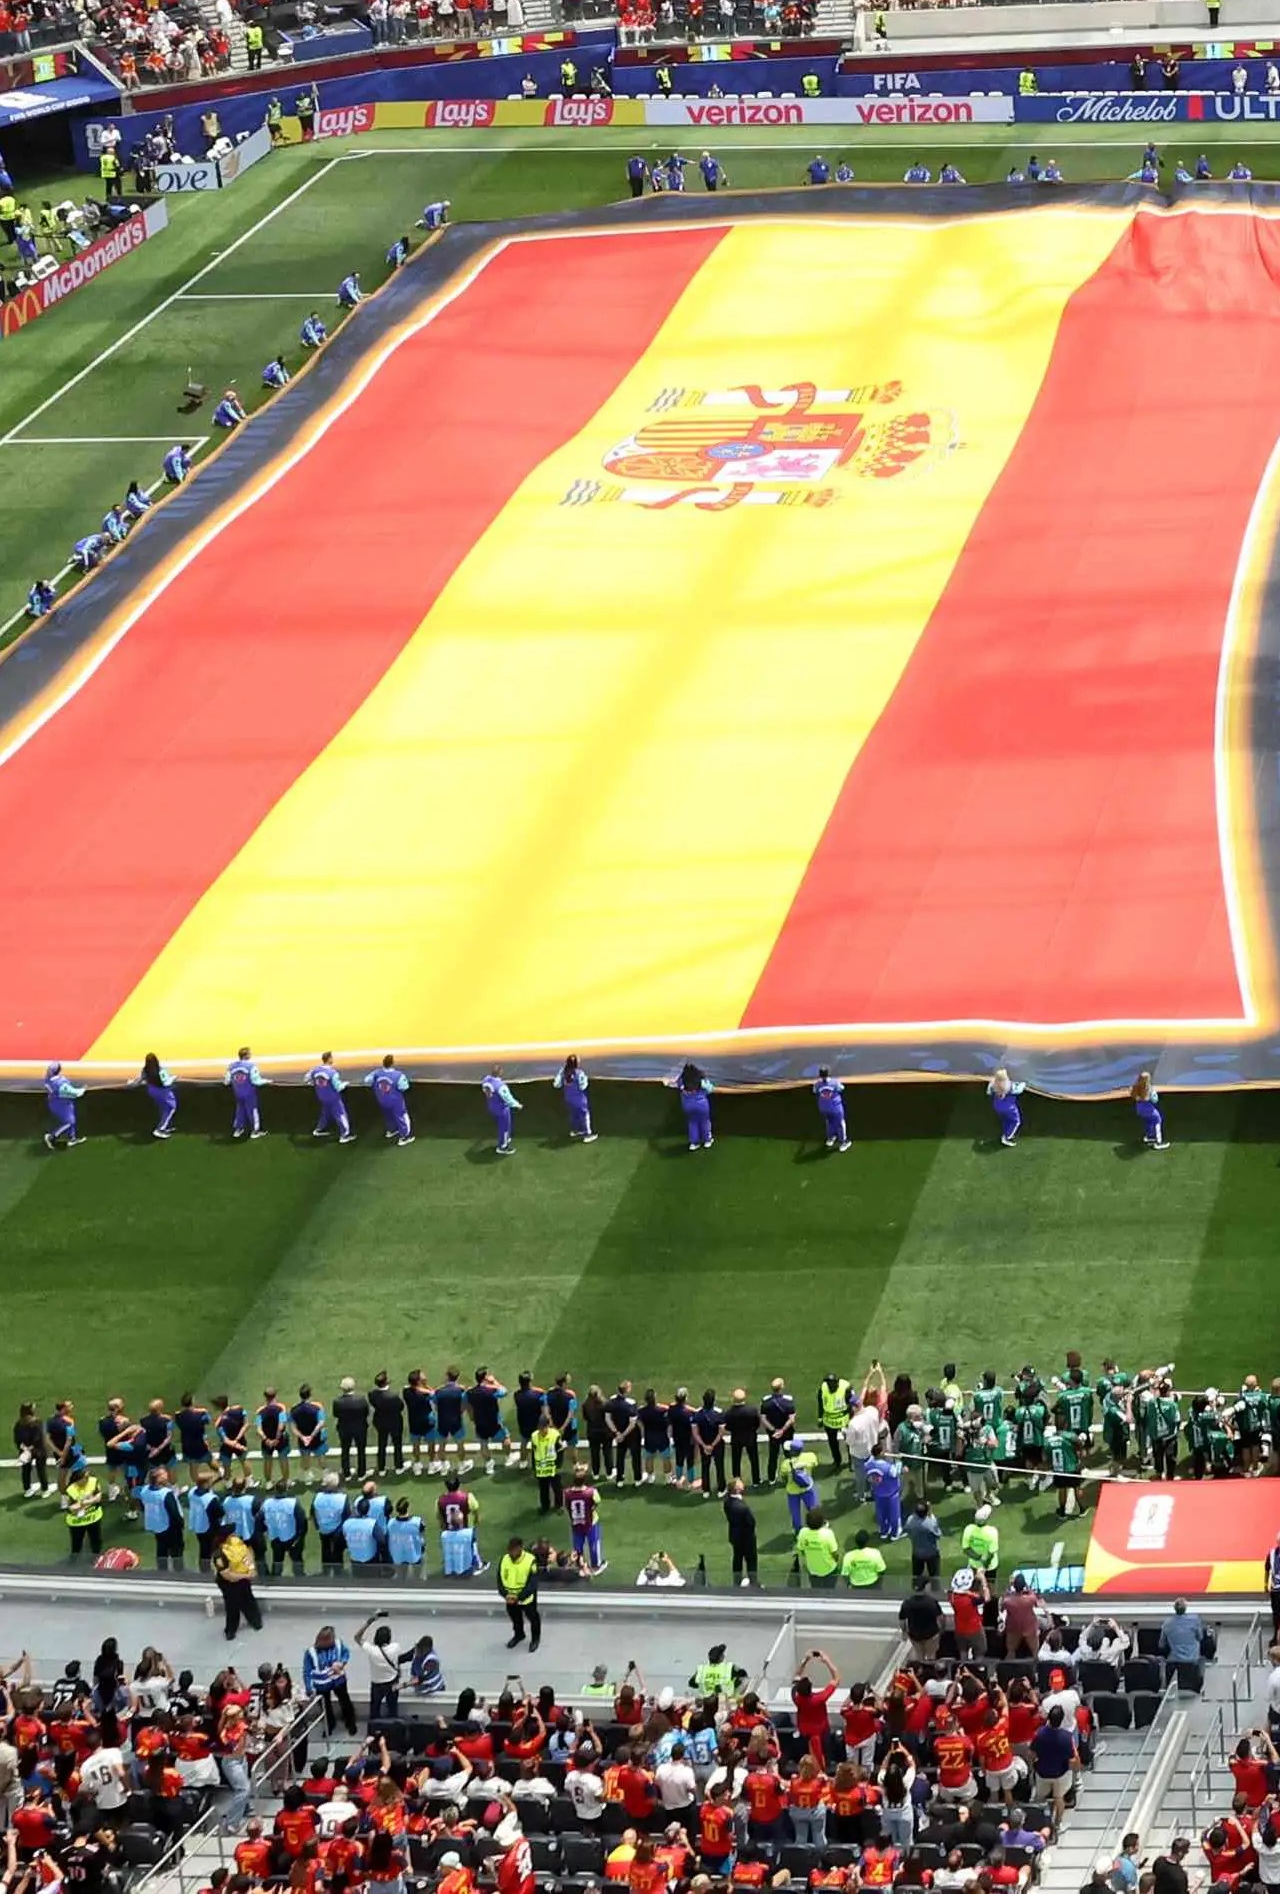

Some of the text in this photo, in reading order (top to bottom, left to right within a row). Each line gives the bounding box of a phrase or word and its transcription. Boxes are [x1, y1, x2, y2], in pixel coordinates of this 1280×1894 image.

[874, 73, 921, 91] FIFA
[433, 99, 489, 128] Lay's
[552, 97, 607, 126] Lay's
[686, 99, 804, 125] verizon
[856, 98, 973, 124] verizon
[1057, 95, 1178, 122] Michelob
[156, 167, 208, 192] ove
[42, 221, 146, 308] McDonald's
[939, 1750, 964, 1769] 22
